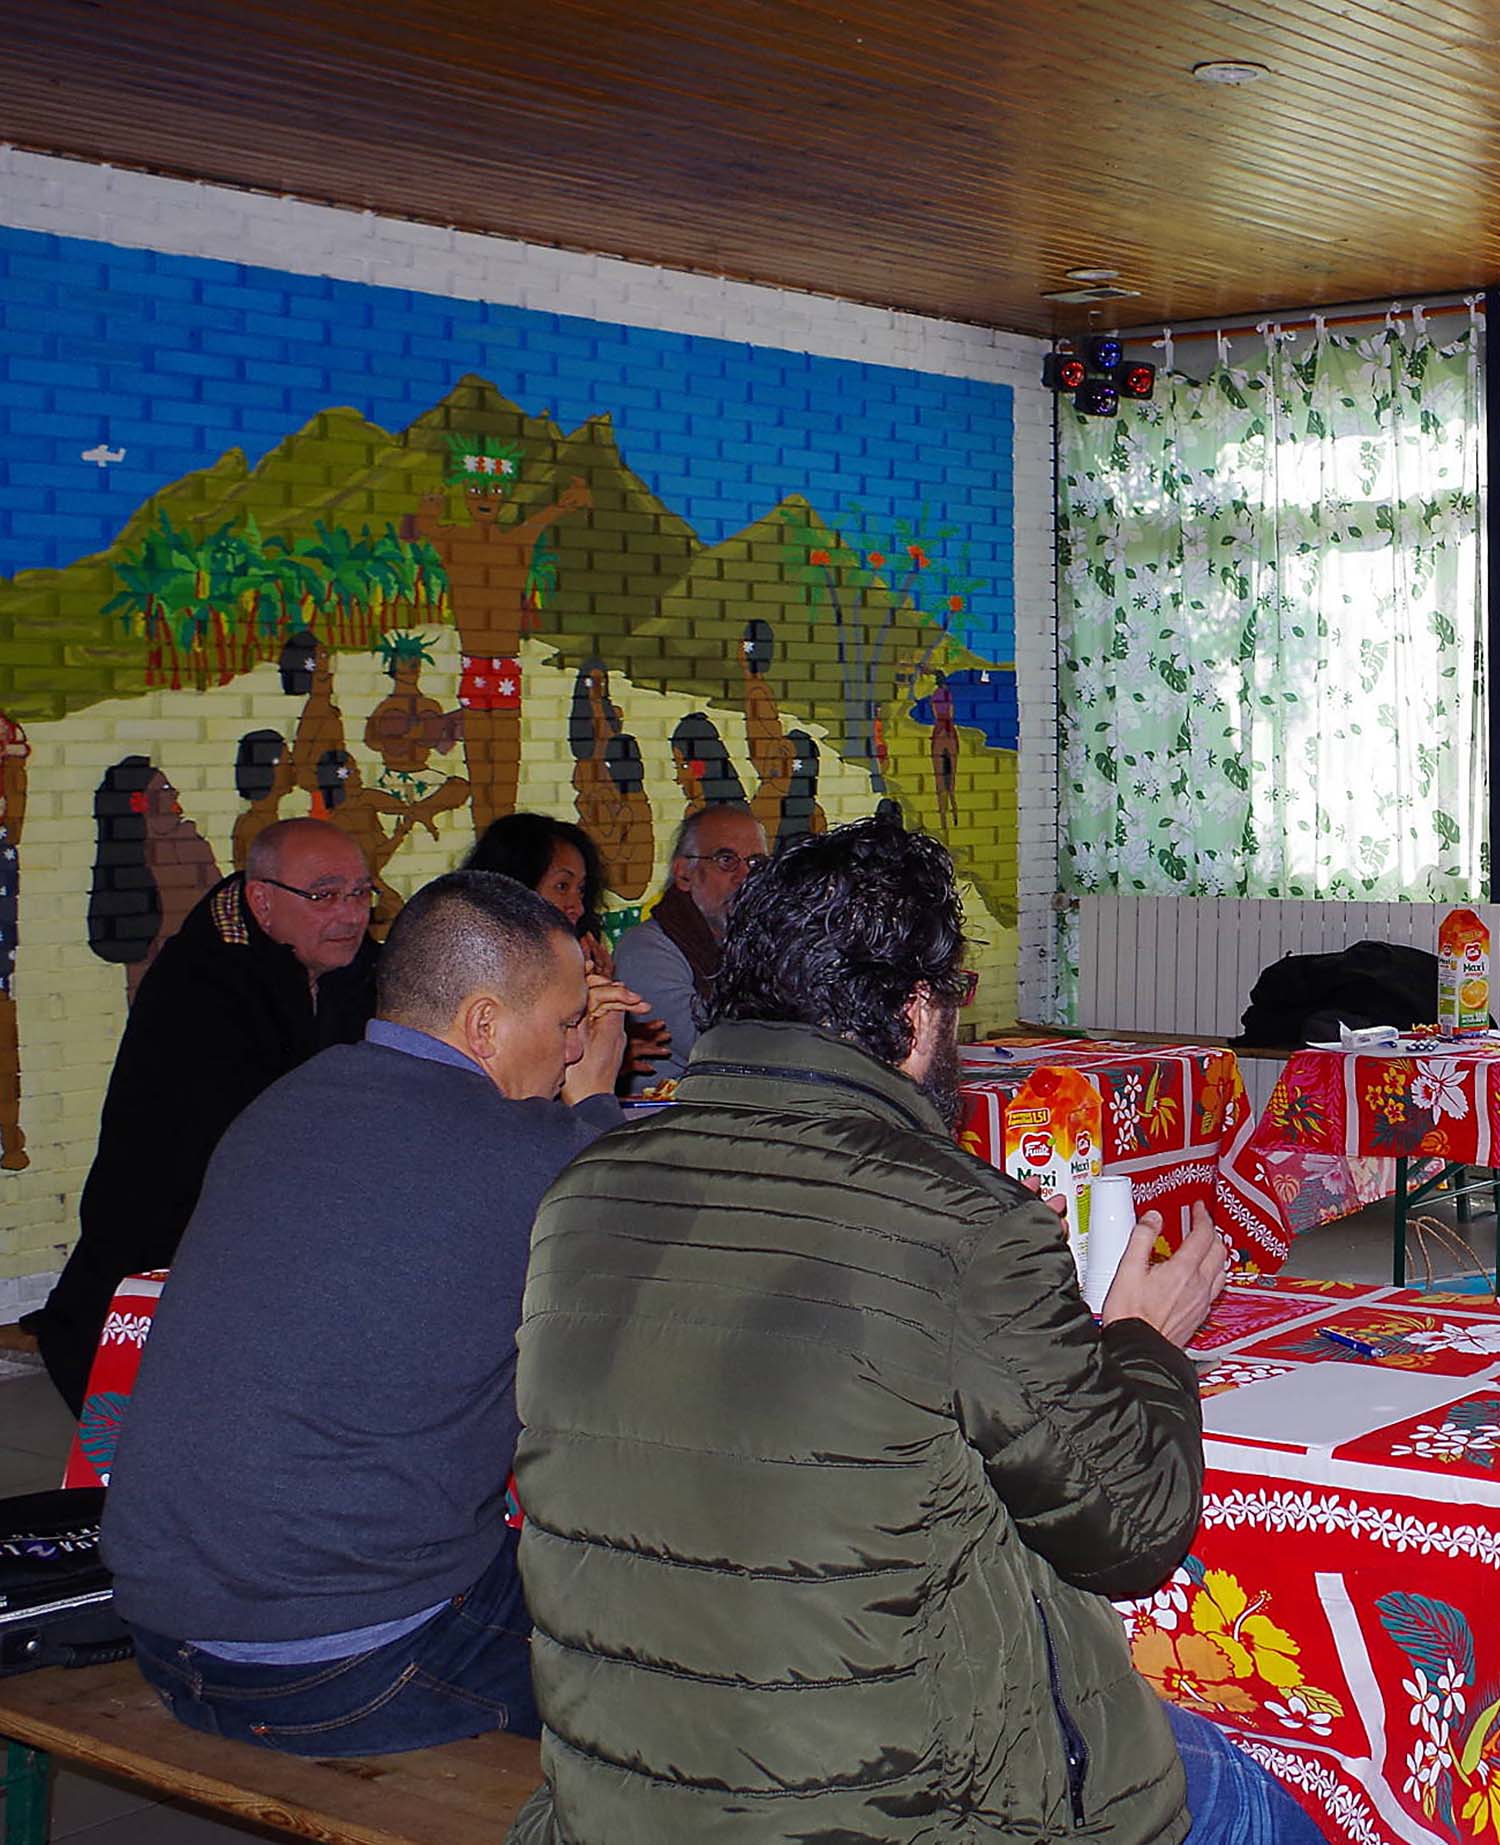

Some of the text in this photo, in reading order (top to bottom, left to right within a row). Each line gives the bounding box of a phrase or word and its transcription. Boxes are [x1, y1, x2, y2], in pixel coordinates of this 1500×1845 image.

[1463, 962, 1485, 972] Maxi
[1071, 1159, 1089, 1174] Maxi
[1017, 1167, 1057, 1187] Mxi
